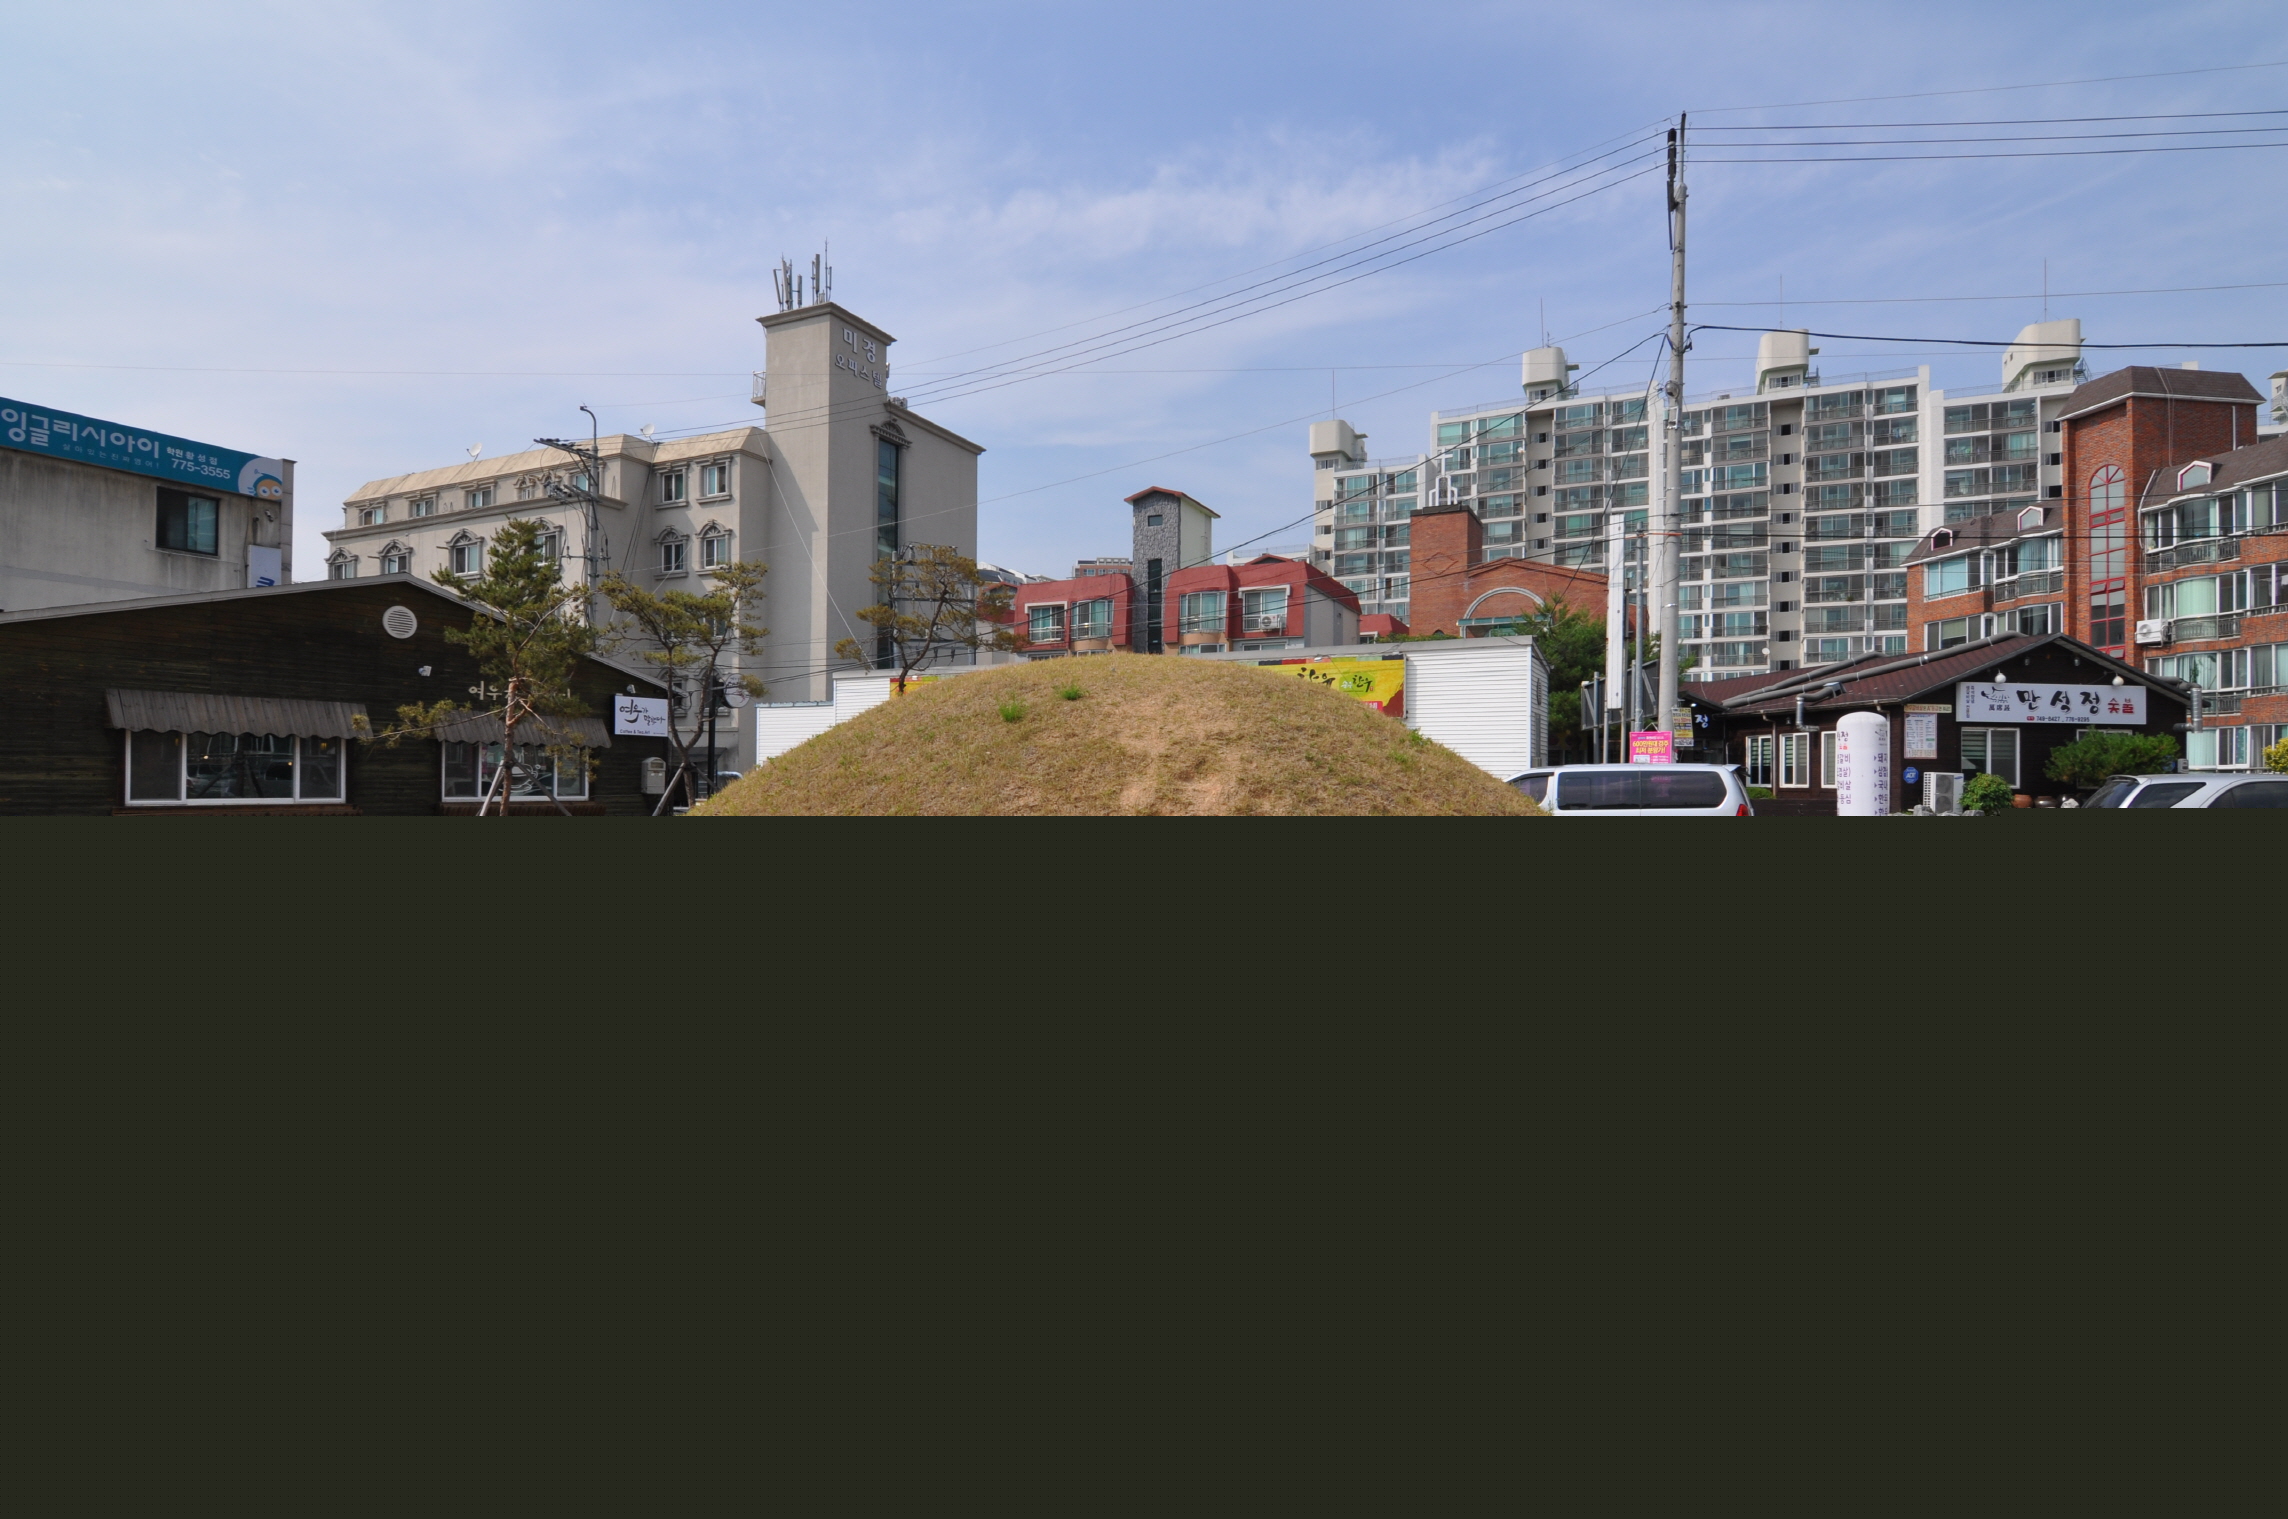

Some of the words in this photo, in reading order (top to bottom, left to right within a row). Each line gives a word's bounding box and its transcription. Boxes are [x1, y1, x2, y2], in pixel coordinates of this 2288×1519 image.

[842, 328, 876, 363] 미경
[835, 354, 882, 389] 오피스텔
[1, 408, 160, 459] 잉글리시아이
[171, 459, 231, 479] 775-3555
[1694, 714, 1709, 728] 정
